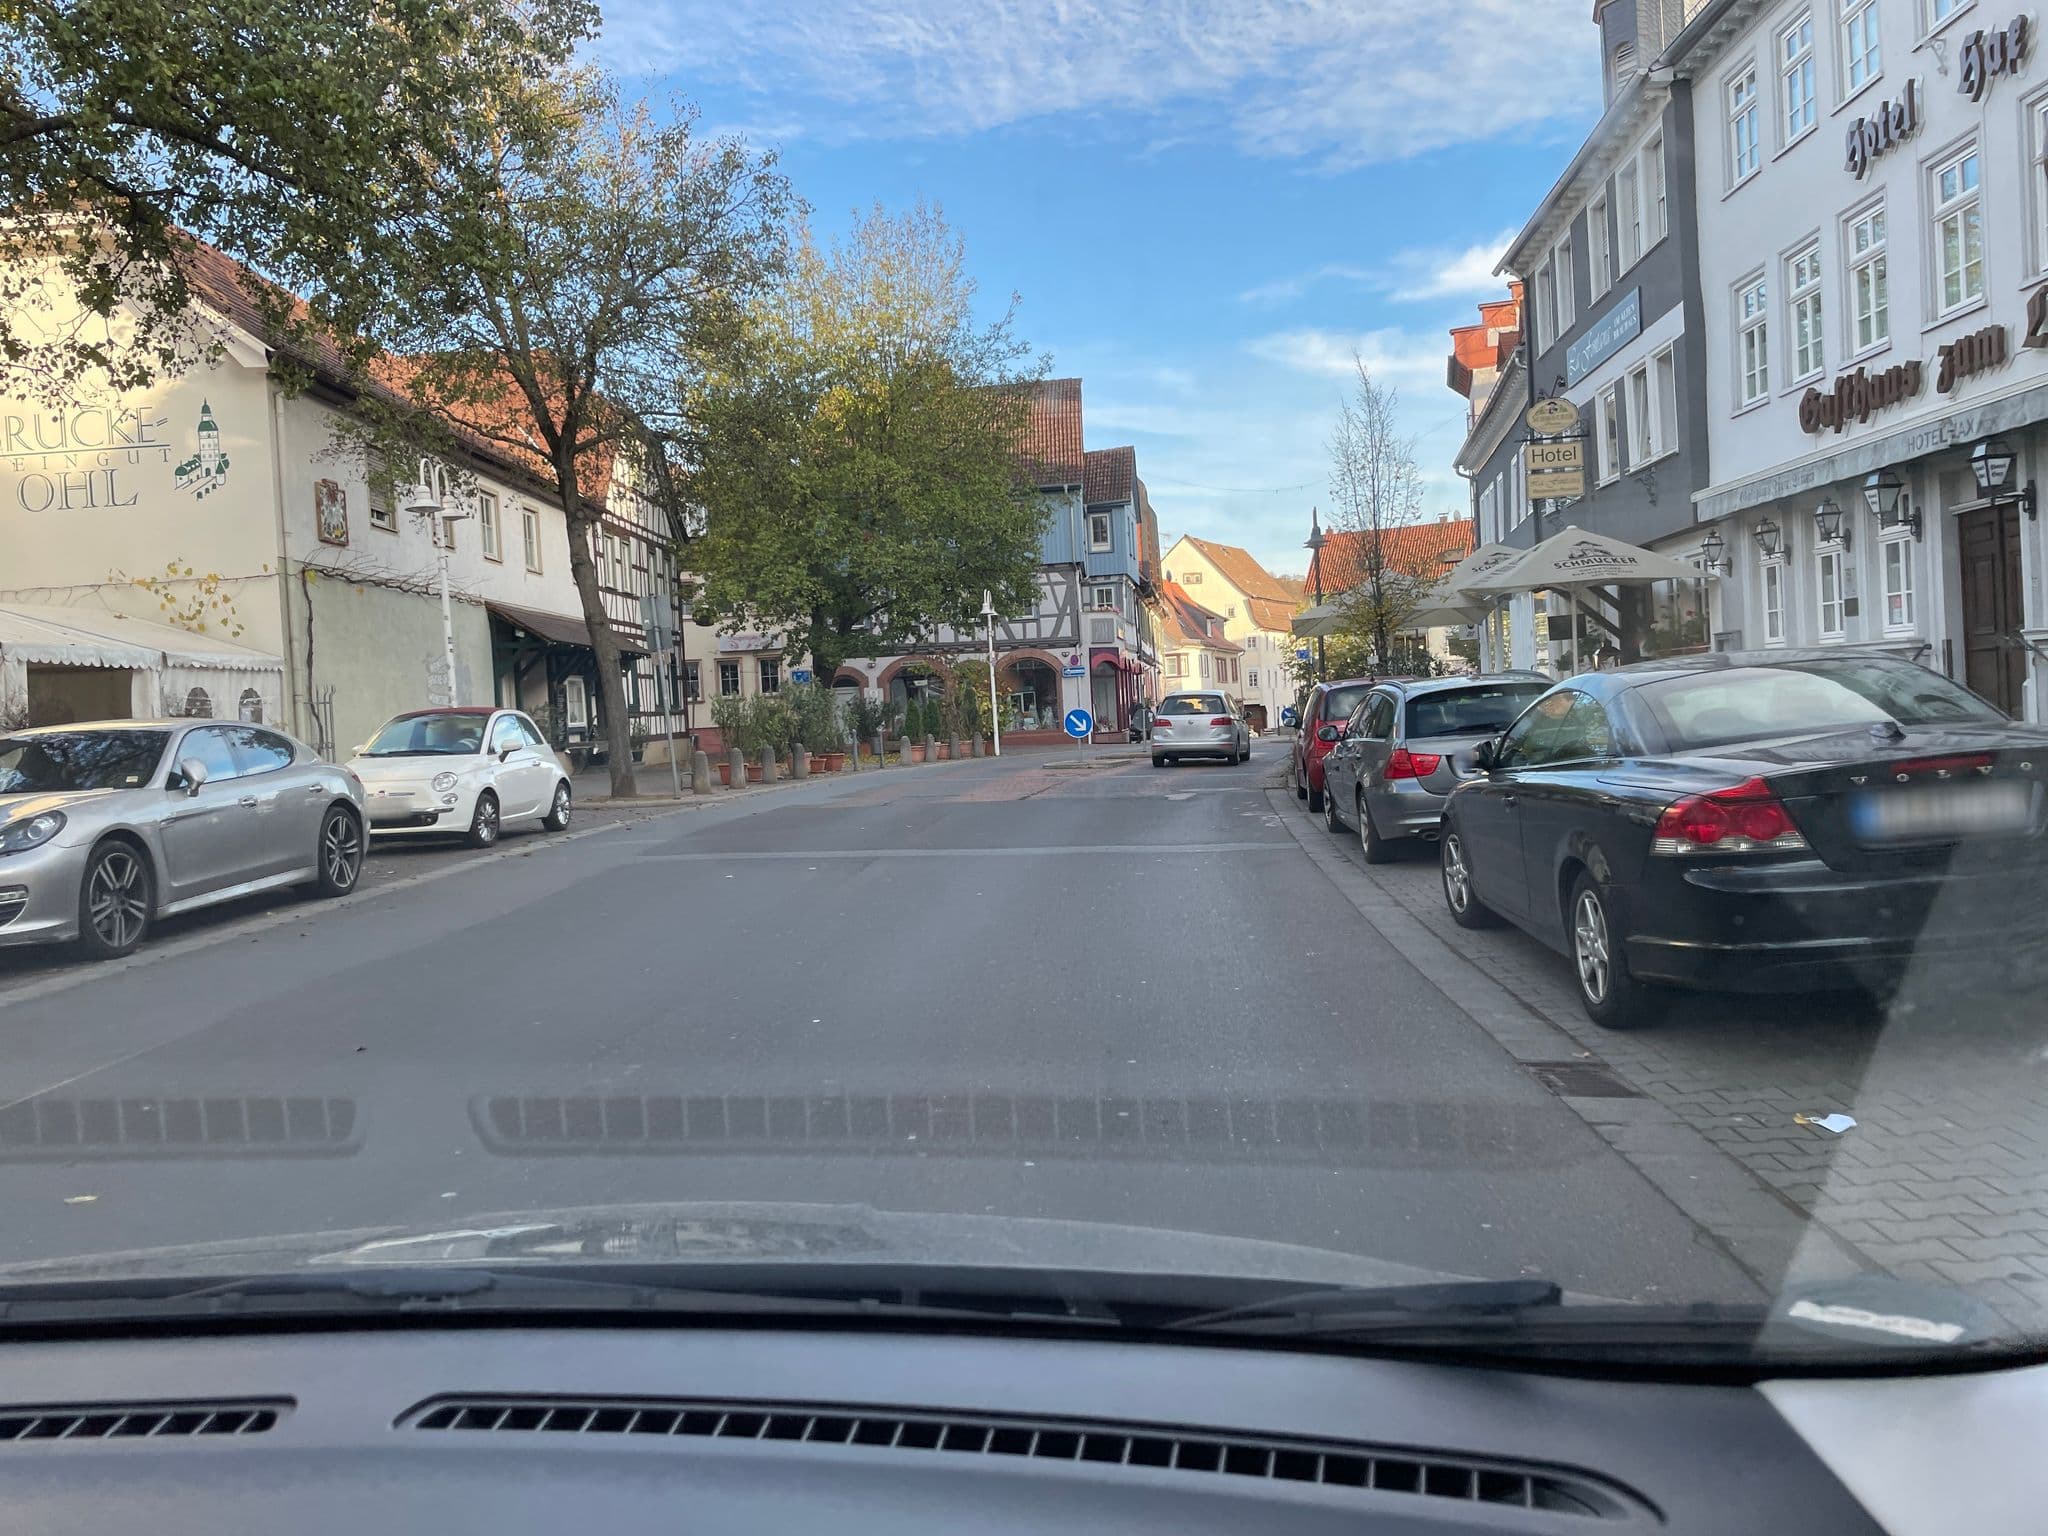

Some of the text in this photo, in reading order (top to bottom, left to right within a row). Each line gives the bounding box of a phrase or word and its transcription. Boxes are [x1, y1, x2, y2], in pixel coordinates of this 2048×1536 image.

[1843, 78, 1916, 180] Hotel
[1799, 360, 1922, 434] Gasthaus
[0, 403, 169, 451] RÜCKE-
[11, 448, 171, 472] EINGUT
[1532, 446, 1577, 463] Hotel
[17, 468, 139, 513] OHL
[1553, 556, 1638, 570] SCHMUCKER
